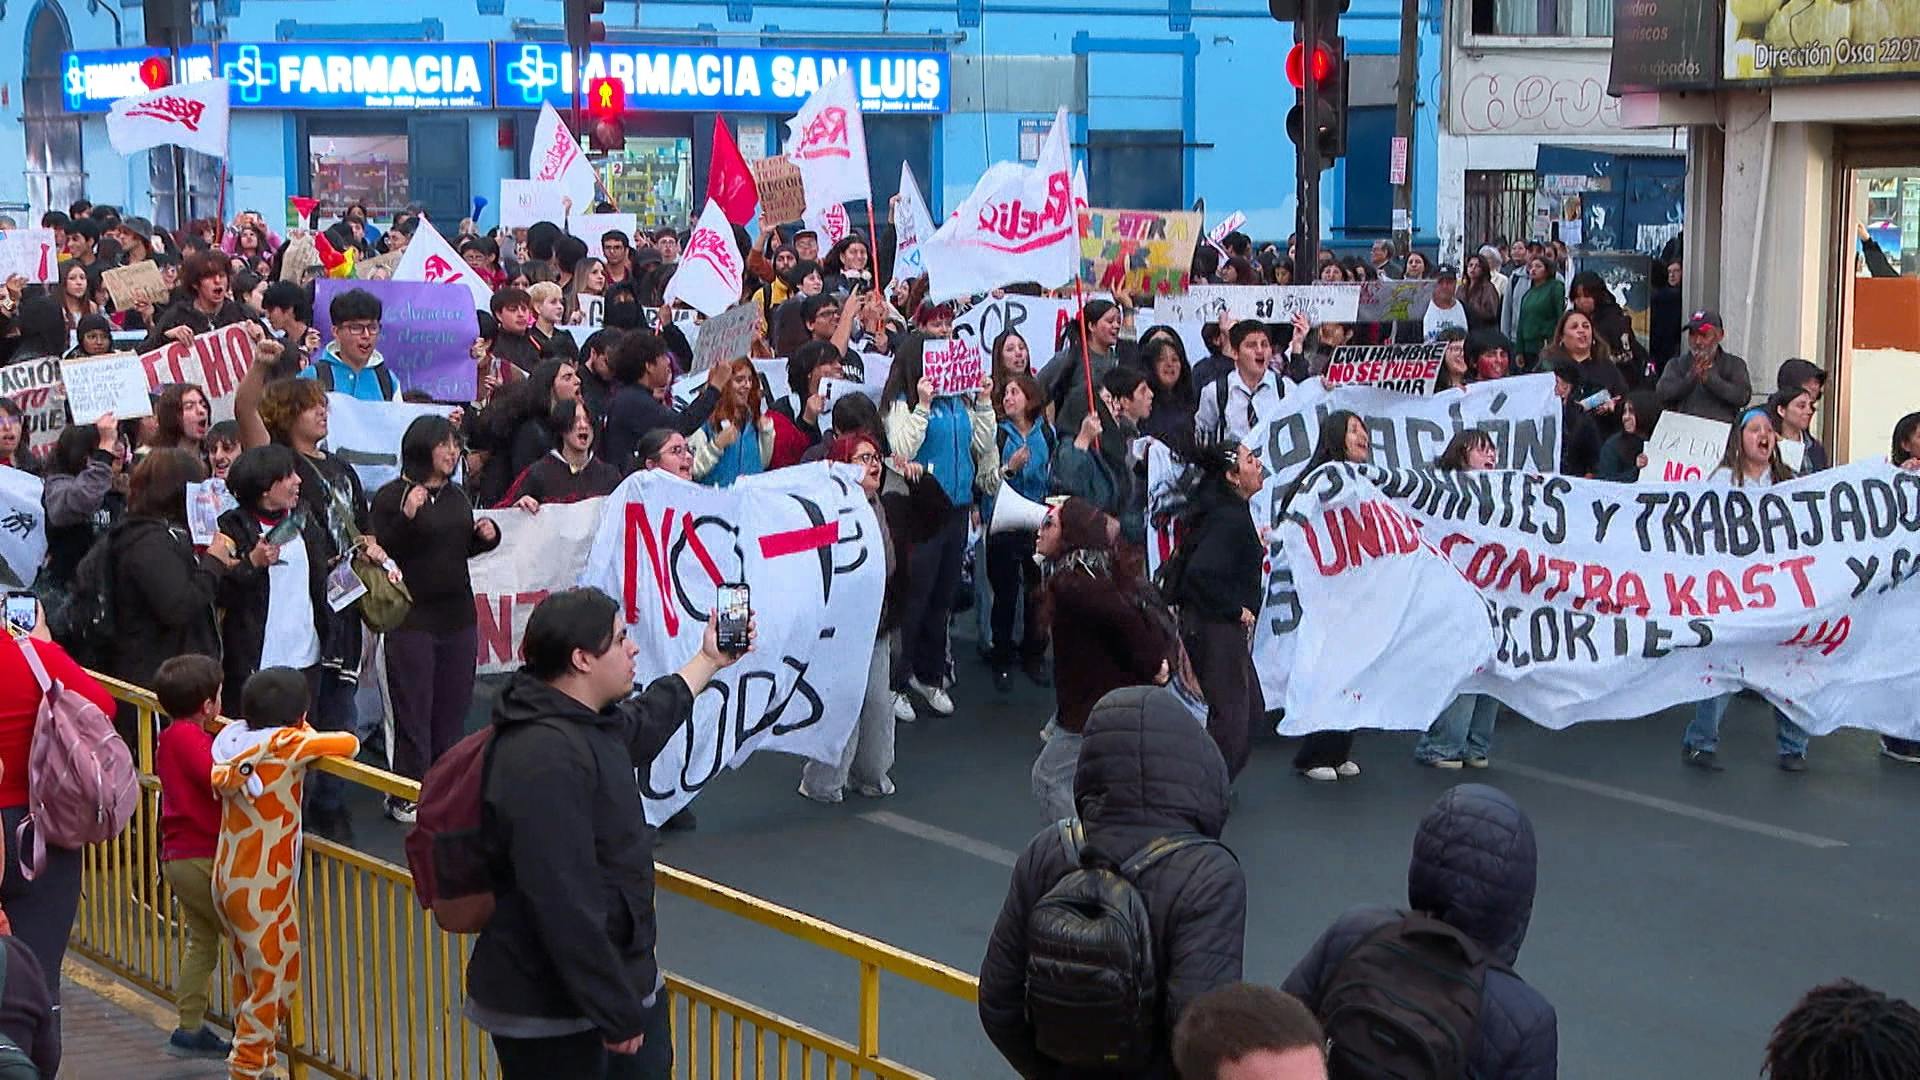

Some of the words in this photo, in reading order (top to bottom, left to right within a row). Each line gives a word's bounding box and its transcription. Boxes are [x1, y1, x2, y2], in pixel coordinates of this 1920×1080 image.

[1754, 40, 1831, 70] Dirección
[1836, 37, 1875, 64] Ossa
[237, 55, 271, 86] SL
[278, 55, 482, 93] FARMACIA
[560, 54, 762, 97] FARMACIA
[771, 57, 849, 98] SAN
[860, 58, 940, 98] LUIS
[1327, 363, 1354, 383] NO
[1356, 361, 1383, 381] SE
[1383, 359, 1440, 380] PUEDE
[1333, 346, 1369, 364] CON
[1369, 343, 1447, 362] HAMBRE
[1663, 460, 1702, 482] NO
[1591, 499, 1621, 544] Y
[1663, 554, 1817, 618] KAST
